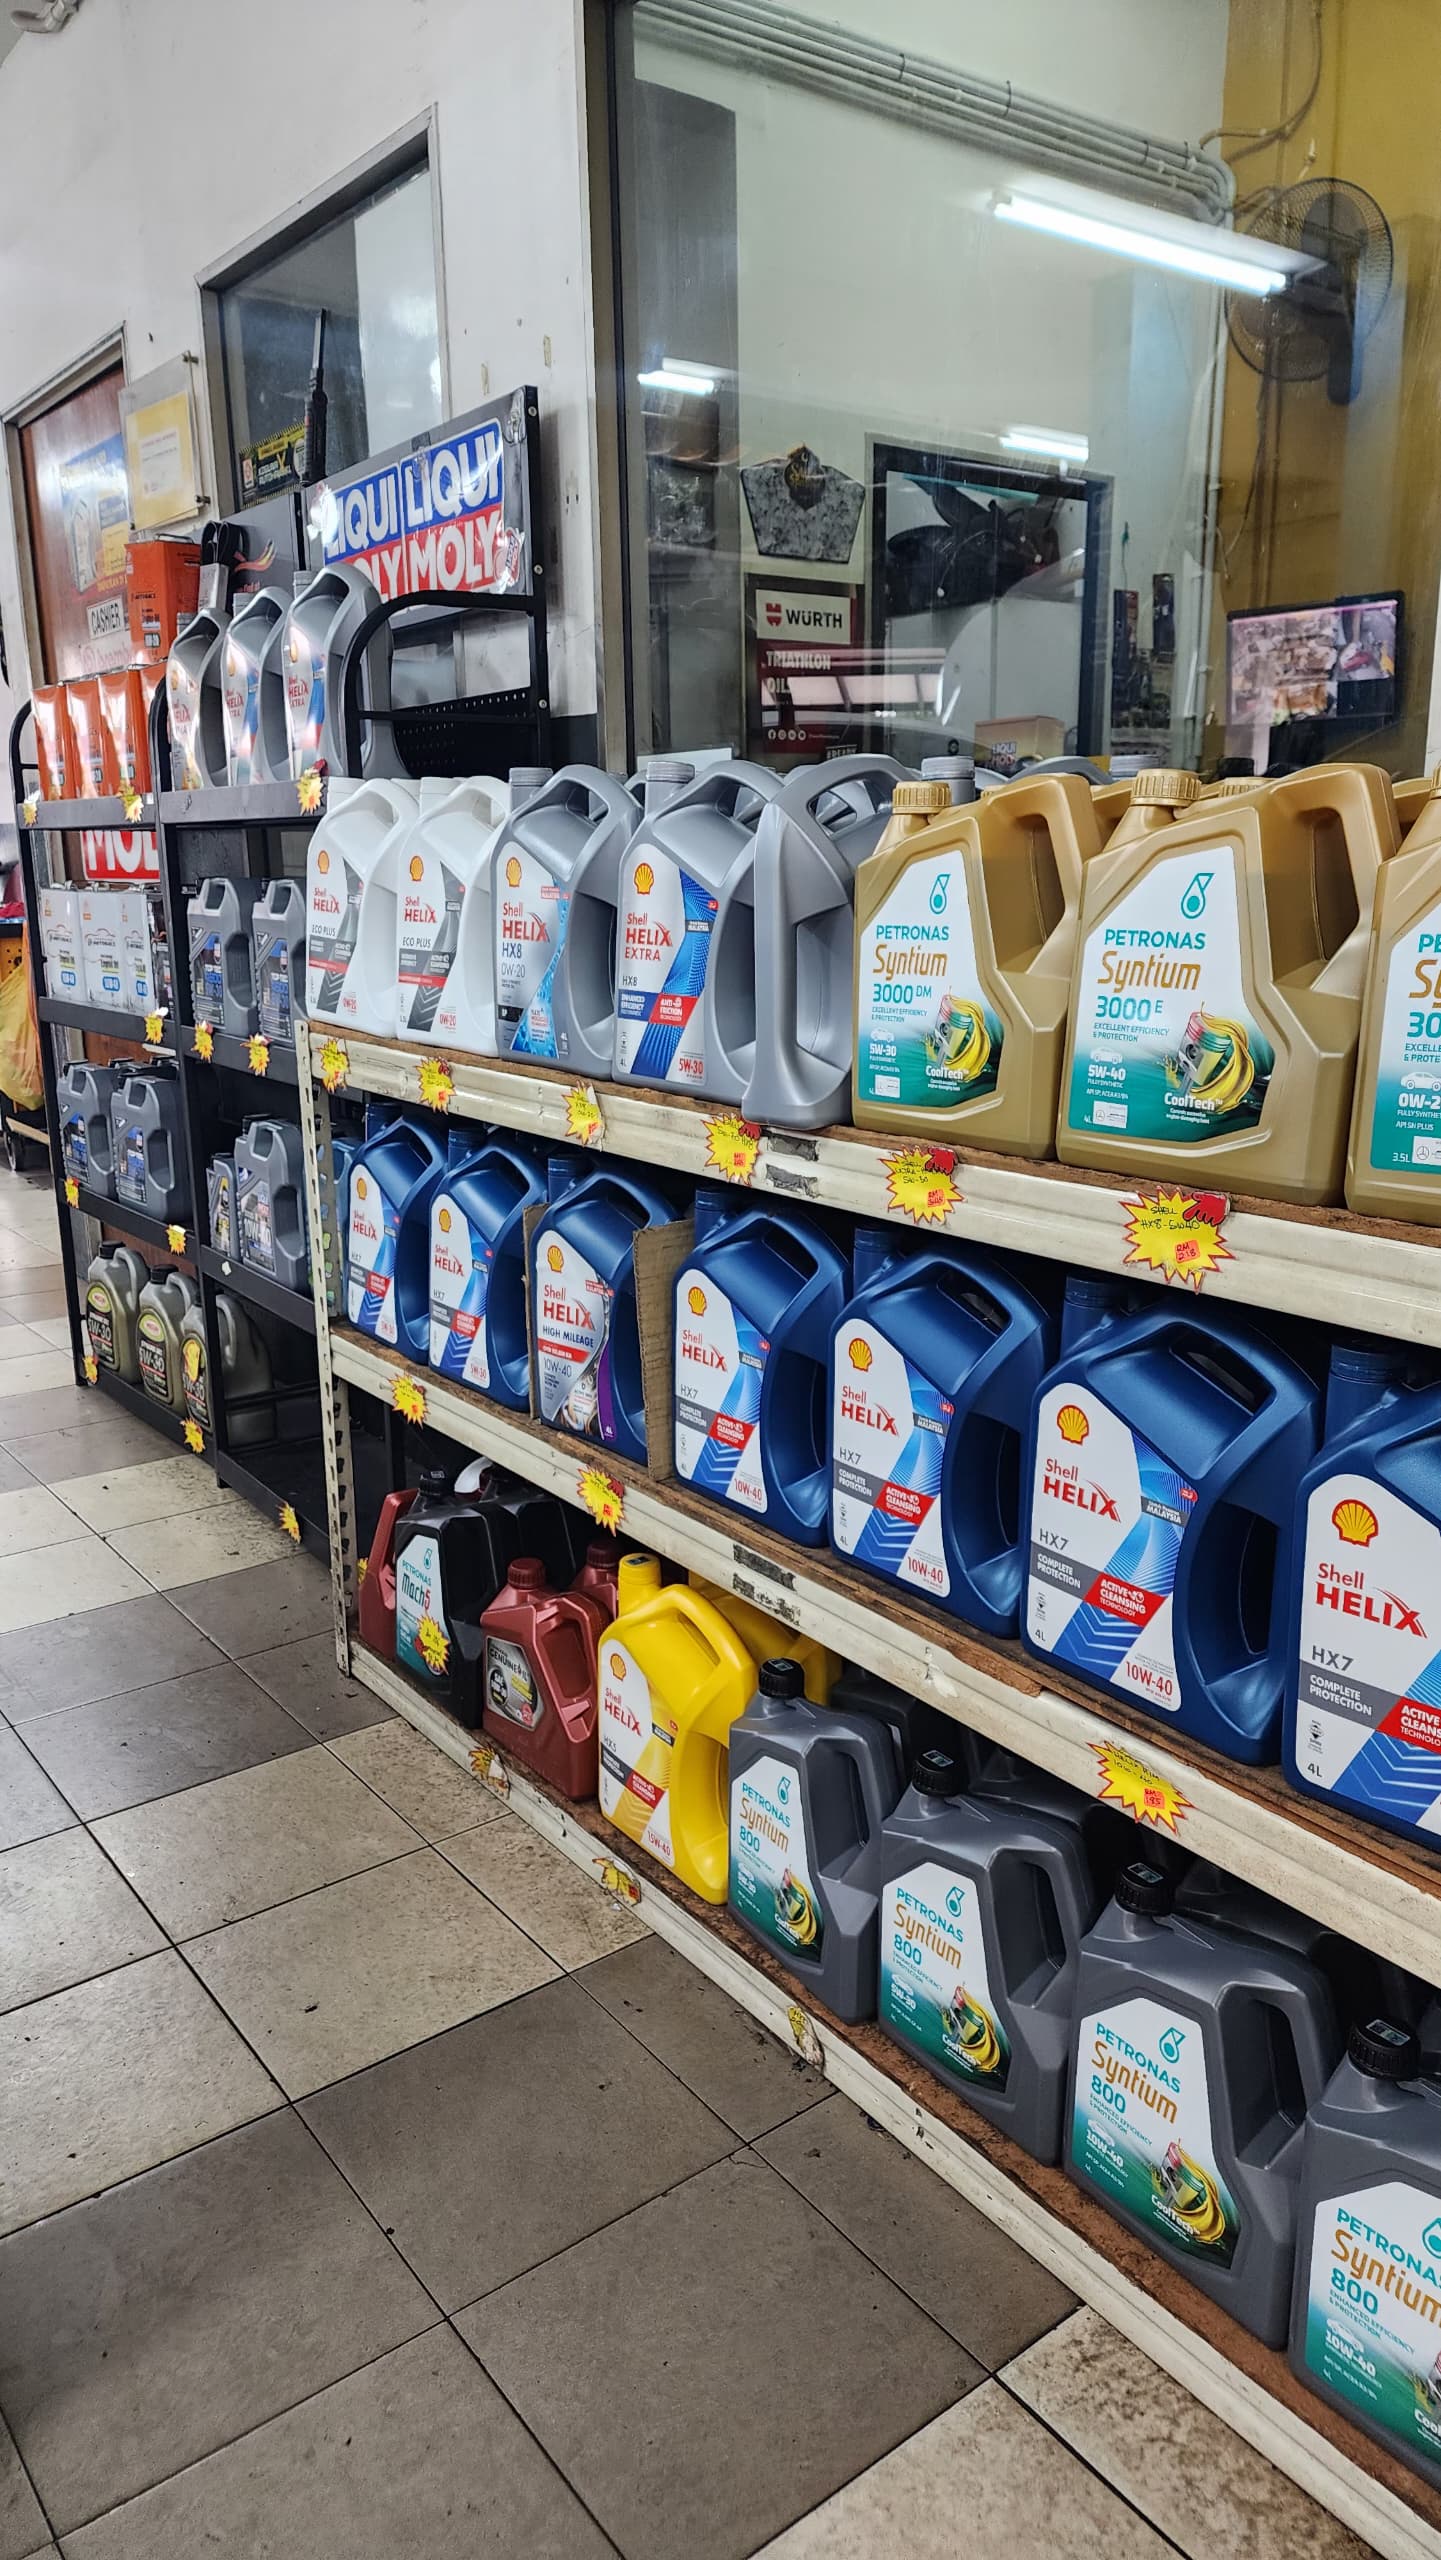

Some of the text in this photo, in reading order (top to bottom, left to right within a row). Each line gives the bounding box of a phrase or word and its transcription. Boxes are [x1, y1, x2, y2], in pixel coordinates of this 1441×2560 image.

[405, 431, 499, 527] LIQUI
[408, 511, 500, 593] MOLY
[91, 602, 121, 635] CASHIER
[785, 608, 843, 629] WÜRTH
[766, 651, 832, 671] TRIATHLON
[313, 896, 340, 913] HELIX
[405, 896, 420, 906] Shell
[502, 902, 523, 918] Shell
[404, 906, 437, 924] HELIX
[627, 913, 647, 925] Shell
[323, 926, 336, 937] PLUS
[502, 916, 550, 942] HELIX
[625, 926, 673, 947] HELIX
[876, 925, 949, 941] PETRONAS
[1104, 928, 1206, 950] PETRONAS
[402, 936, 431, 949] ECO PLUS
[502, 942, 522, 959] HX8
[625, 947, 661, 961] EXTRA
[501, 963, 526, 978] 0W-20
[873, 944, 948, 981] Syntium
[1097, 950, 1201, 993] Syntium
[622, 975, 638, 986] HX8
[872, 984, 932, 1004] 3000 DM
[1095, 995, 1164, 1022] 3000 E
[1094, 1022, 1169, 1036] EXCELLENT EFFICIENCY
[1097, 1032, 1138, 1042] PROTECTION
[869, 1043, 897, 1057] 5W-30
[679, 1058, 704, 1075] 5W-30
[1088, 1064, 1126, 1081] 5W-40
[1392, 1151, 1411, 1163] 3.5L
[353, 1222, 377, 1241] HELIX
[435, 1244, 449, 1256] Shell
[434, 1256, 465, 1277] HELIX
[433, 1288, 445, 1300] HX7
[544, 1284, 566, 1301] Shell
[543, 1300, 596, 1331] HELIX
[88, 1317, 112, 1342] 5W-30
[542, 1325, 594, 1348] HIGH MILEAGE
[682, 1329, 703, 1345] Shell
[139, 1347, 165, 1373] 5W-30
[543, 1357, 572, 1378] 10W-40
[681, 1343, 728, 1372] HELIX
[680, 1384, 698, 1399] HX7
[842, 1385, 867, 1404] Shell
[840, 1402, 899, 1436] HELIX
[839, 1446, 862, 1466] HX7
[839, 1467, 867, 1487] COMPLETE
[1046, 1458, 1079, 1482] Shell
[734, 1478, 762, 1501] 10W-40
[839, 1477, 873, 1497] PROTECTION
[886, 1486, 907, 1502] ACTIVE
[886, 1495, 921, 1515] CLEANSING
[1042, 1475, 1121, 1523] HELIX
[1146, 1504, 1182, 1524] MALAYSIA
[839, 1534, 849, 1547] 4L
[1039, 1527, 1068, 1551] HX7
[402, 1560, 432, 1588] PETRONAS
[907, 1556, 944, 1584] 10W-40
[1037, 1552, 1074, 1577] COMPLETE
[1037, 1562, 1081, 1590] PROTECTION
[1317, 1562, 1364, 1590] Shell
[401, 1571, 431, 1610] Mach5
[1100, 1578, 1128, 1599] ACTIVE
[1100, 1588, 1146, 1615] CLEANSING
[1100, 1598, 1136, 1617] TECHNOLOGY
[1315, 1581, 1428, 1639] HELIX
[1034, 1628, 1046, 1643] 4L
[1311, 1645, 1354, 1673] HX7
[1125, 1660, 1173, 1696] 10W-40
[1309, 1673, 1361, 1702] COMPLETE
[605, 1687, 622, 1705] Shell
[1309, 1684, 1372, 1716] PROTECTION
[604, 1699, 641, 1737] HELIX
[1401, 1704, 1440, 1727] ACTIVE
[1307, 1762, 1322, 1779] 4L
[742, 1782, 791, 1828] PETRONAS
[740, 1797, 789, 1853] Syntium
[740, 1825, 760, 1852] 800
[896, 1887, 964, 1943] PETRONAS
[893, 1903, 962, 1970] Syntium
[893, 1933, 922, 1966] 800
[1096, 2022, 1181, 2094] PETRONAS
[1091, 2040, 1178, 2125] Syntium
[1091, 2075, 1127, 2115] 800
[1093, 2104, 1128, 2135] PROTECTION
[1119, 2117, 1153, 2146] EFFICIENCY
[1086, 2129, 1124, 2167] 10W-40
[1336, 2207, 1441, 2293] PETRONA
[1331, 2267, 1378, 2315] 800
[1329, 2288, 1415, 2354] ENHANCED EFFICIENCY
[1333, 2299, 1381, 2339] PROTECTION
[1325, 2331, 1377, 2378] 10W-40
